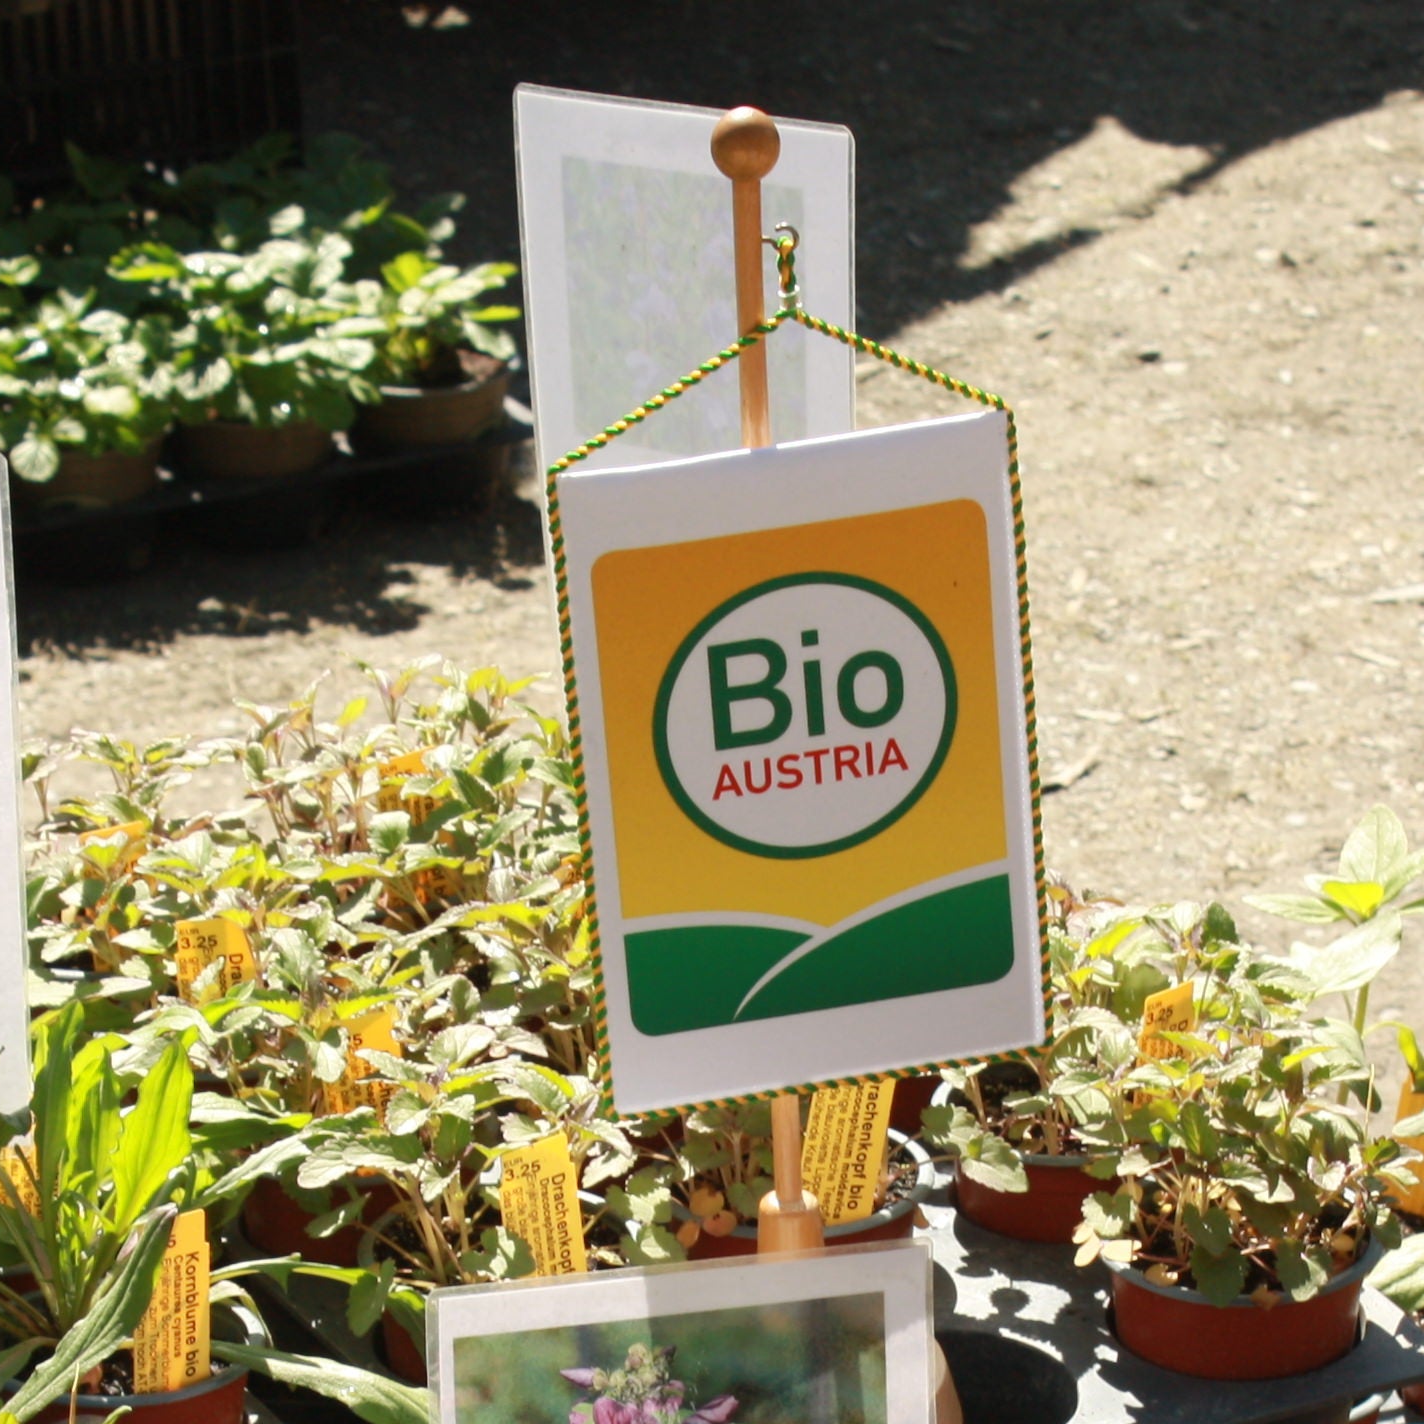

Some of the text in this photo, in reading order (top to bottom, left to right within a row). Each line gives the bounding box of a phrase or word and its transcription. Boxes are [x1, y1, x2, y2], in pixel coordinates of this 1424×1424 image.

[706, 630, 904, 751] Bio
[713, 739, 909, 800] AUSTRIA
[181, 935, 217, 949] 3.25
[505, 1160, 541, 1181] 3.25
[847, 1082, 882, 1210] rachenkopf bio
[551, 1173, 575, 1274] Drachenkopf
[173, 1255, 183, 1357] Centaurea cyanus
[185, 1251, 200, 1377] Kornblume bio
